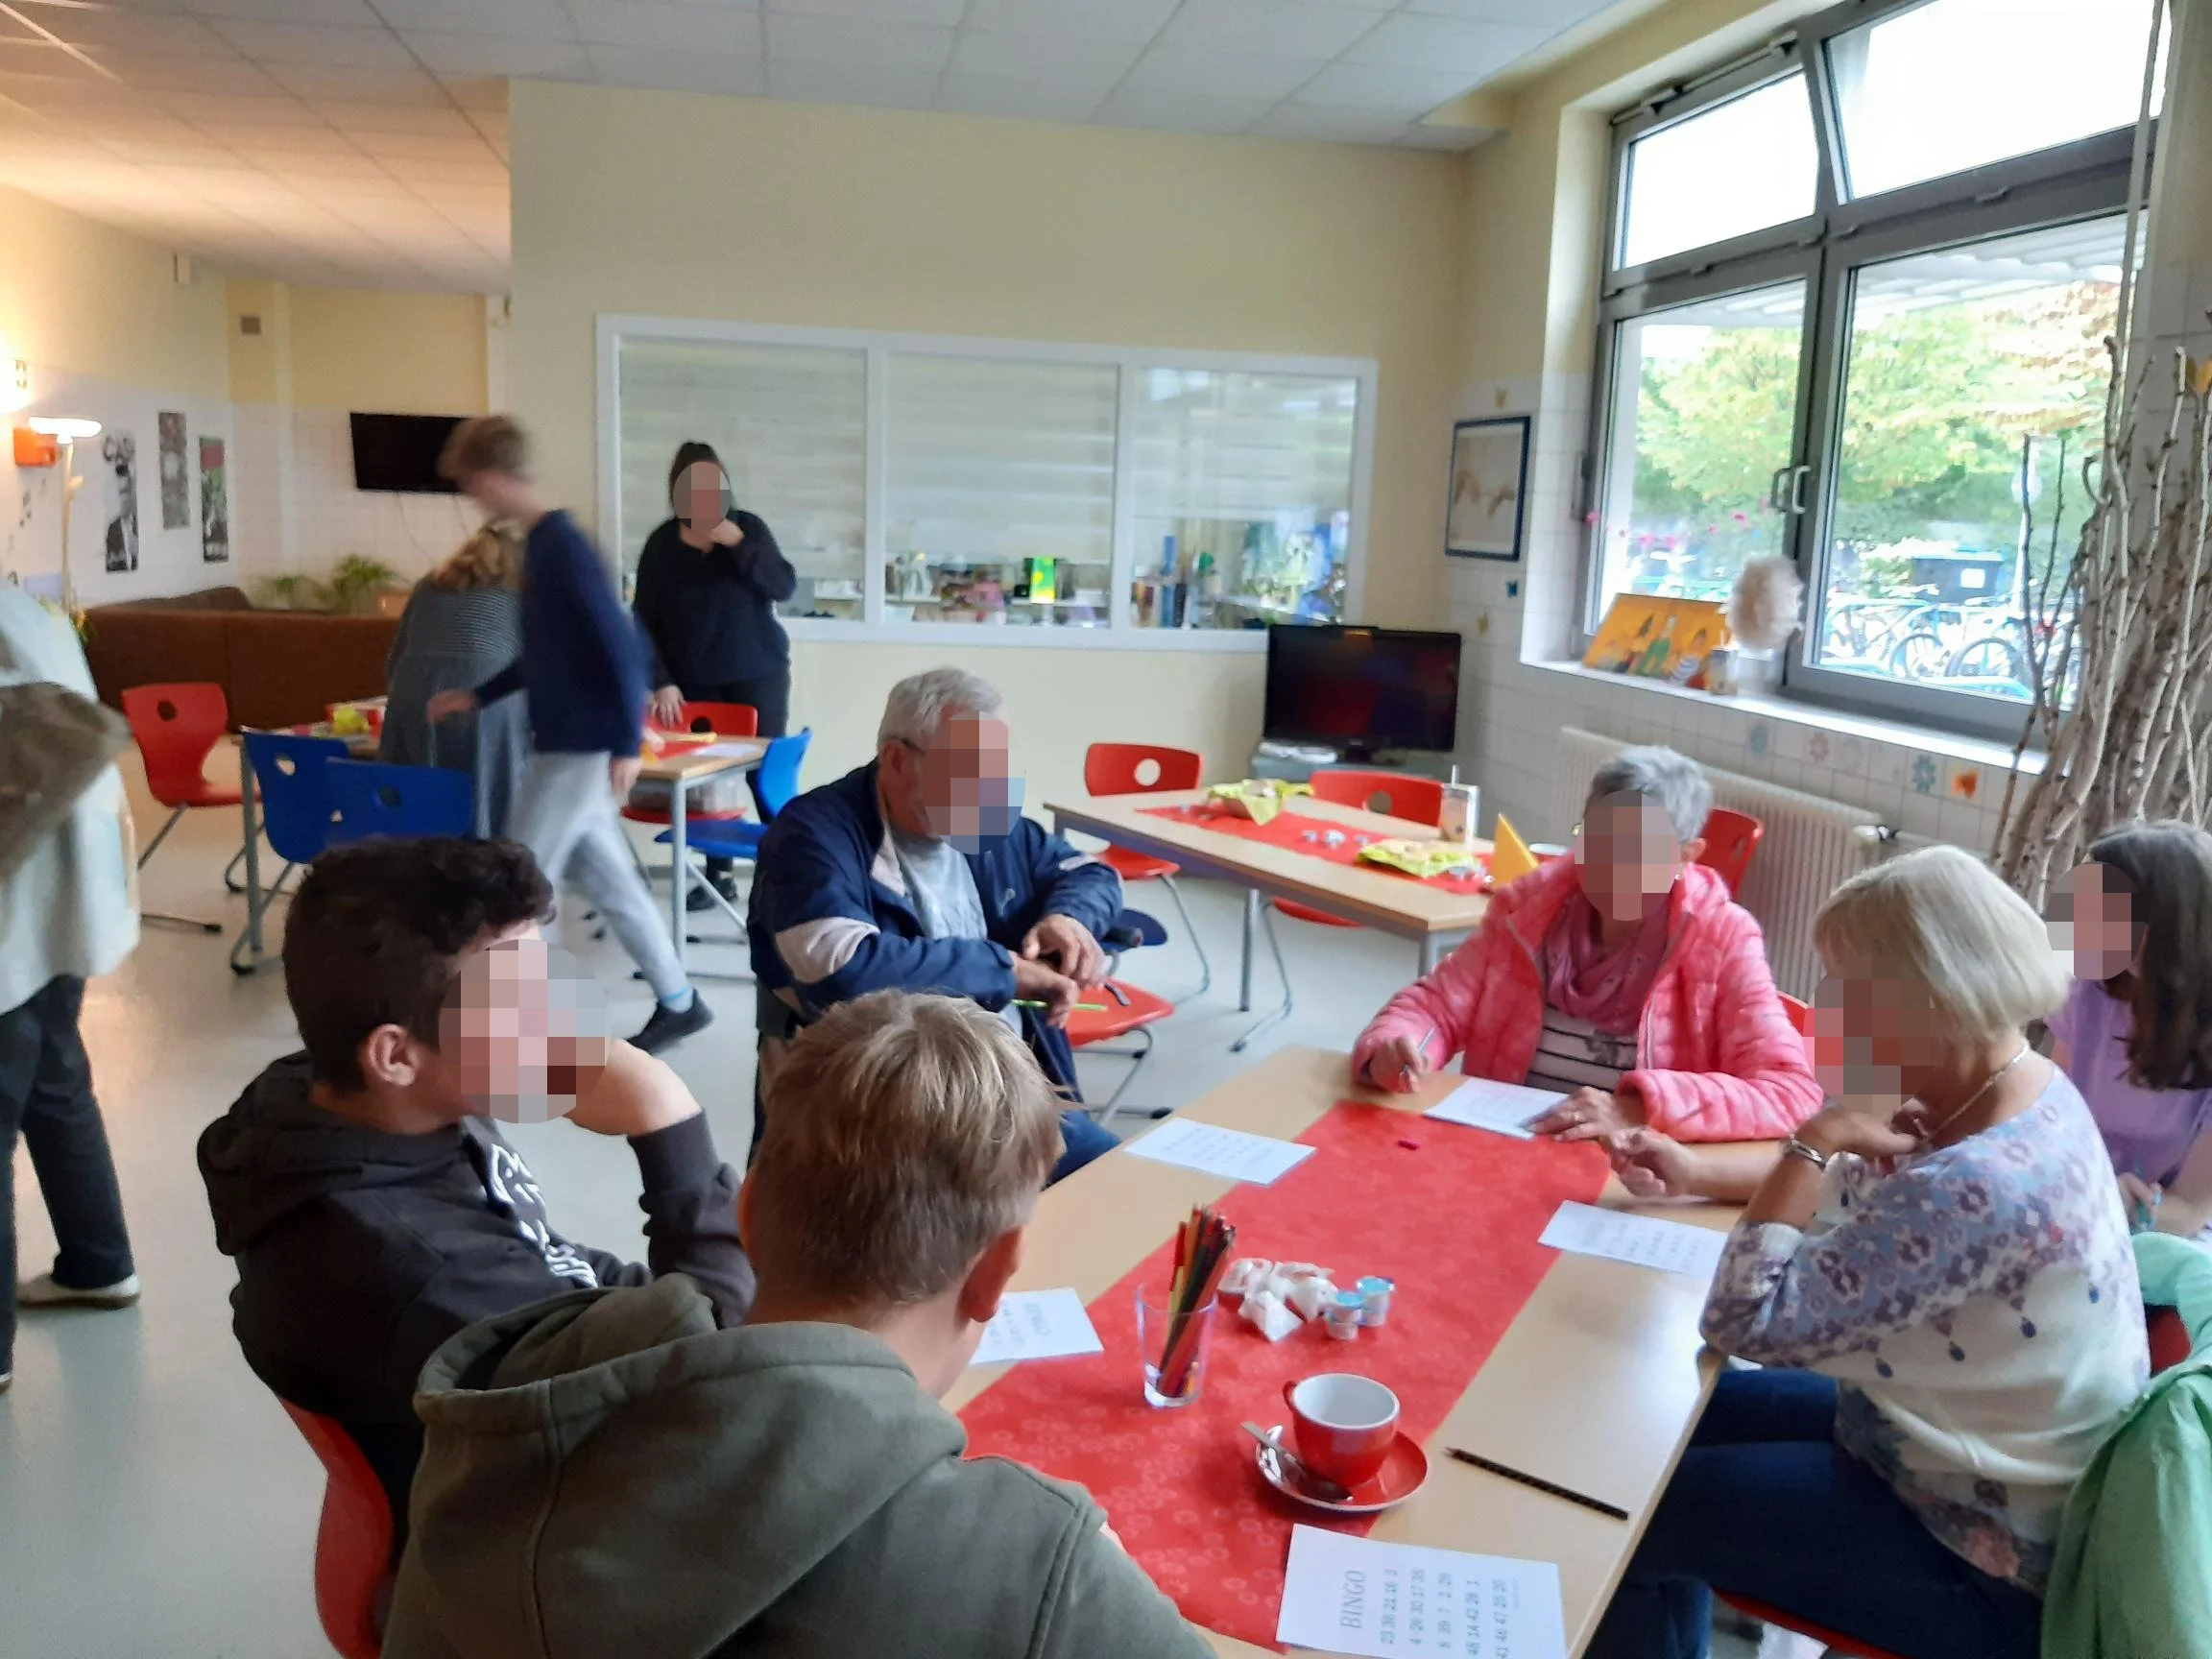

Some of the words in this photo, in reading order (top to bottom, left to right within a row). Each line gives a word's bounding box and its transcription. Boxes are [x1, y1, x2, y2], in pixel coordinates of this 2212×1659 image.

[1410, 1585, 1425, 1598] 17
[1339, 1570, 1365, 1628] BINGO
[1410, 1600, 1423, 1614] 30
[1494, 1611, 1508, 1624] 47
[1380, 1630, 1395, 1644] 23
[1467, 1624, 1479, 1637] 14
